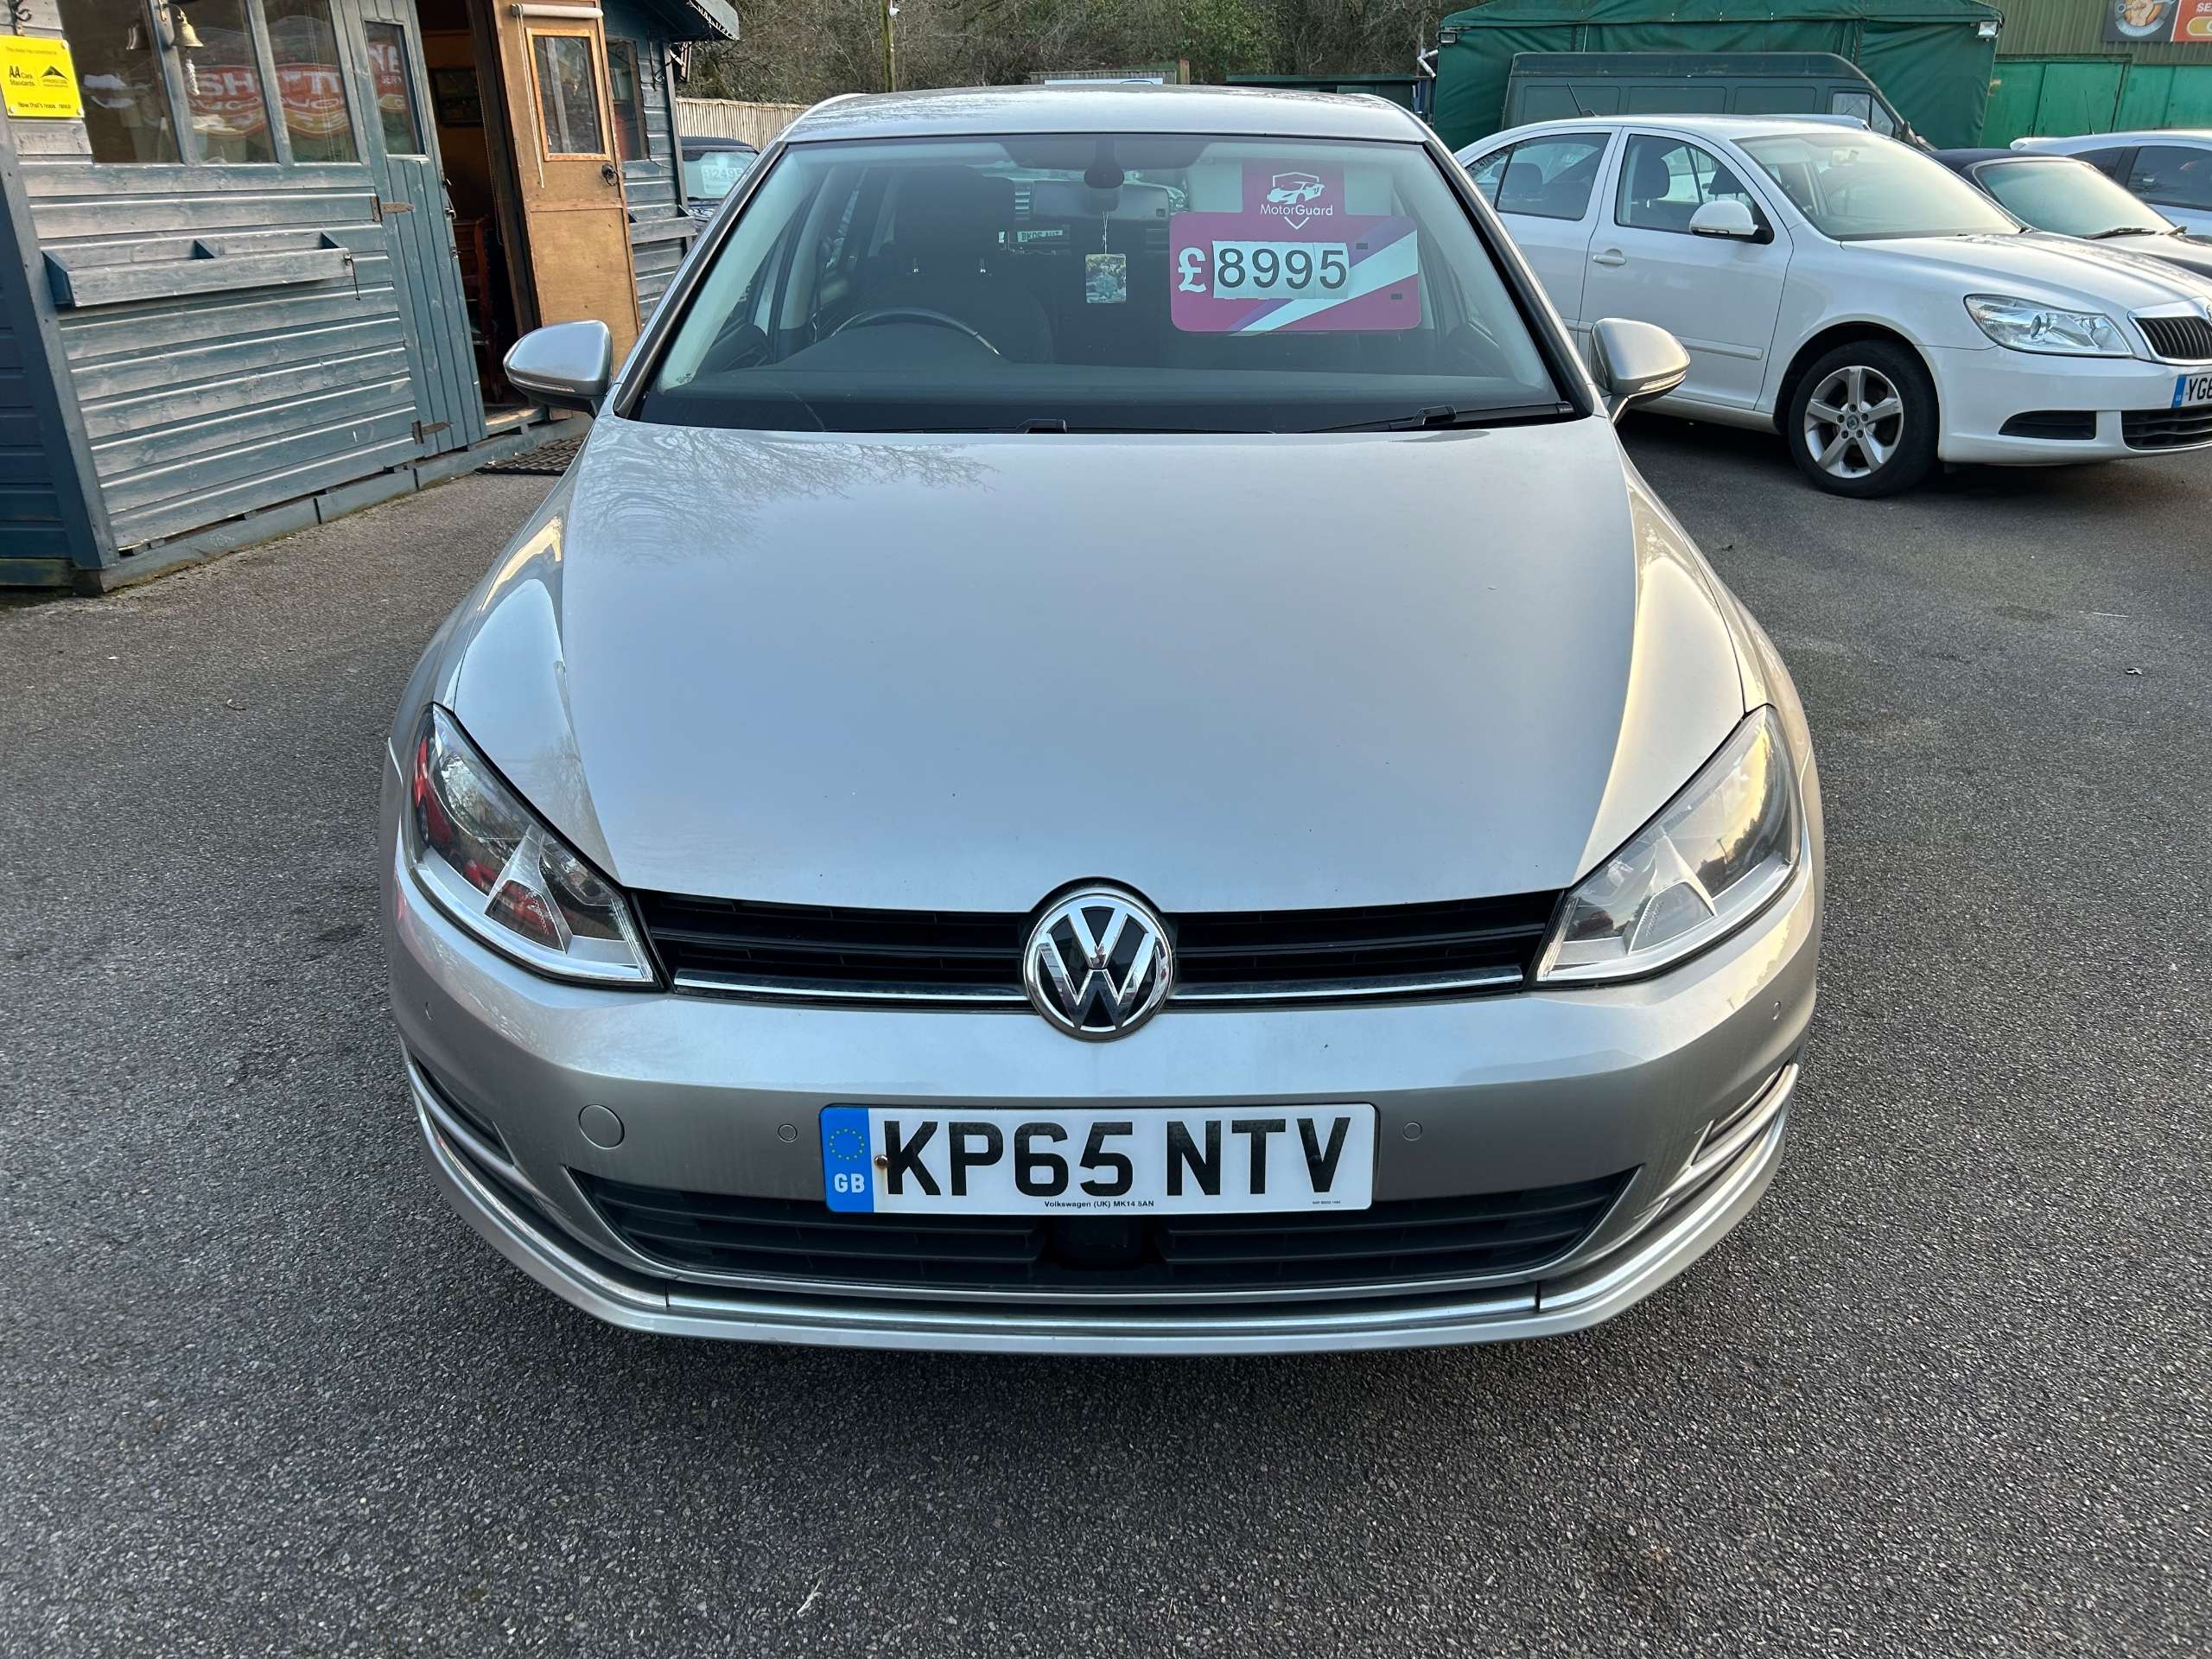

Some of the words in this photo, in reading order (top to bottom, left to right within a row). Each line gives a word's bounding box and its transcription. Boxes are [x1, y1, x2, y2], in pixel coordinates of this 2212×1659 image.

[9, 65, 21, 79] AA
[1260, 204, 1333, 216] MotorGuard
[1031, 895, 1164, 1033] VW
[884, 1121, 1133, 1198] KP65
[1166, 1116, 1351, 1197] NTV
[834, 1173, 865, 1193] GB
[1044, 1200, 1091, 1209] Volkswagen
